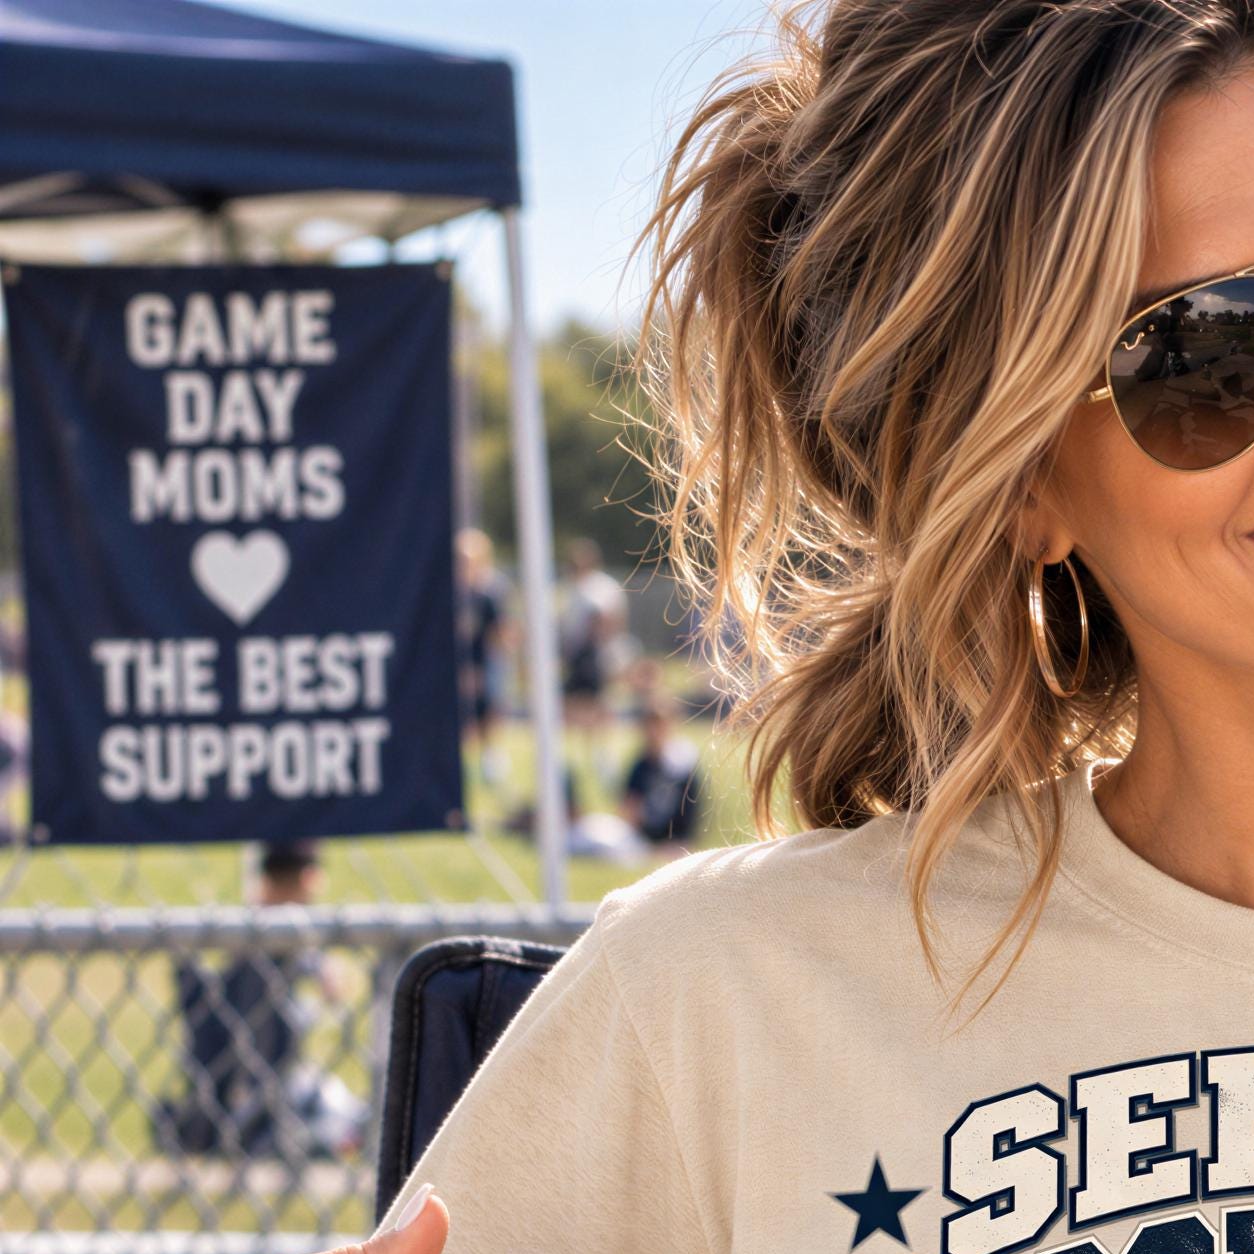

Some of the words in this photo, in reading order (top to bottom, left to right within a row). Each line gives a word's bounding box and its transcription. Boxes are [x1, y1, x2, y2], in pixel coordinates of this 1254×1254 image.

[127, 291, 336, 367] GAME
[166, 370, 303, 445] DAY
[130, 446, 345, 522] MOMS
[92, 638, 220, 715] THE
[238, 632, 394, 713] BEST
[100, 717, 390, 801] SUPPORT
